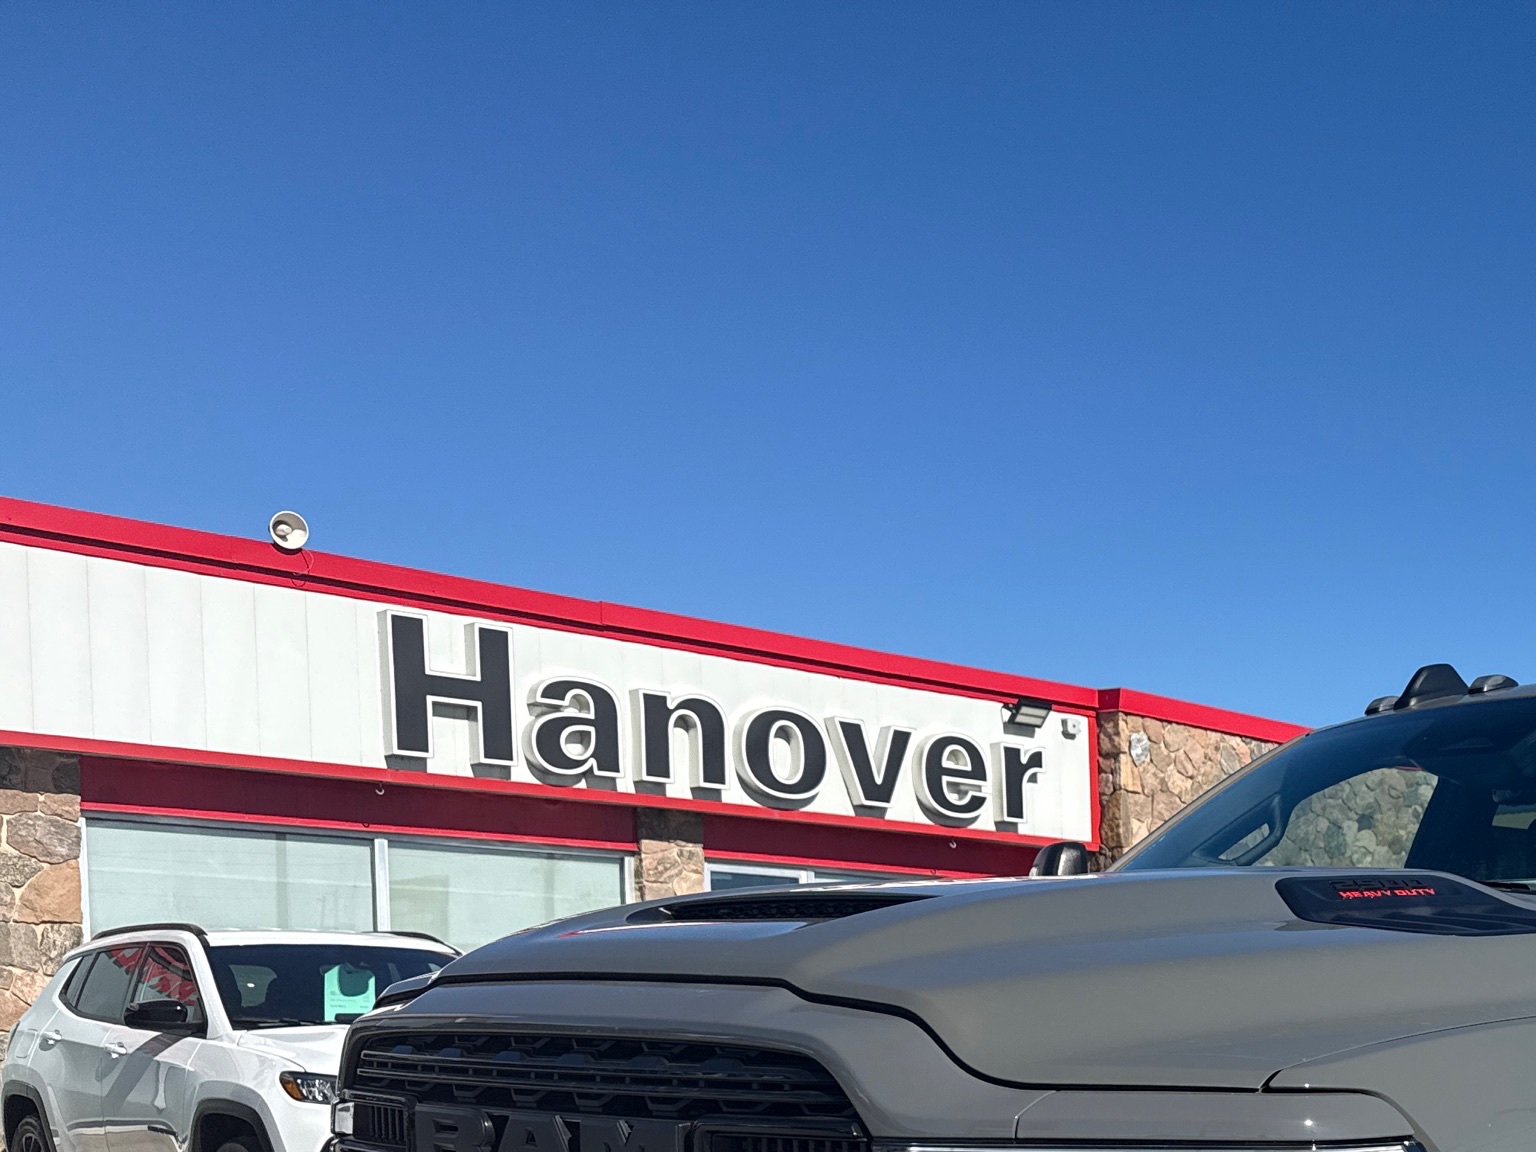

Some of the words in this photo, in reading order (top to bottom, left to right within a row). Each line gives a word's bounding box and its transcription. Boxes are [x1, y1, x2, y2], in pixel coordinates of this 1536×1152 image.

[378, 608, 1044, 824] Hanover
[1338, 889, 1391, 900] HEAVY
[1393, 887, 1436, 898] DUTY
